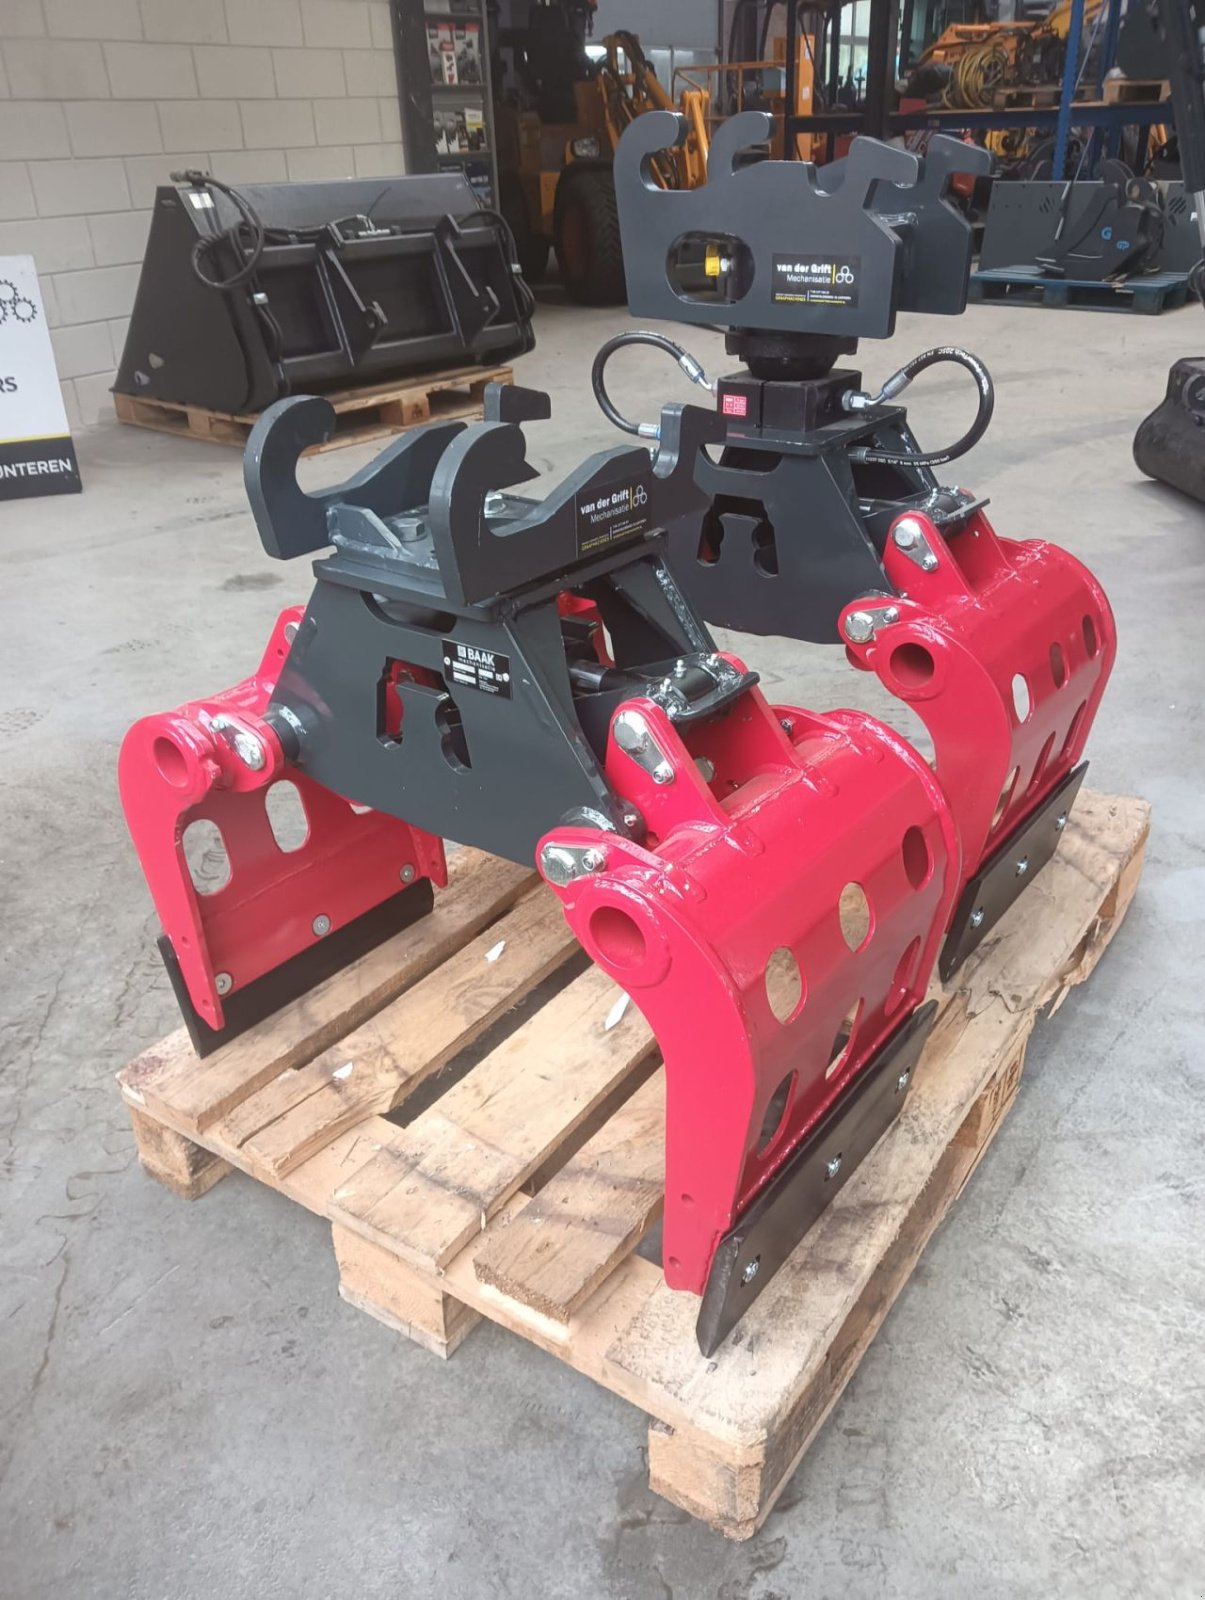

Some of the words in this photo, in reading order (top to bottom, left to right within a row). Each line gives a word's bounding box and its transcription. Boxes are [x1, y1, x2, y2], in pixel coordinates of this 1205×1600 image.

[776, 264, 793, 272] van
[794, 263, 810, 273] der
[811, 263, 832, 274] Grift
[786, 274, 832, 284] Mechanisatie
[580, 502, 595, 515] van
[596, 497, 611, 509] der
[611, 489, 630, 504] Grift
[590, 503, 630, 524] Mechanisatie
[467, 647, 496, 667] BAAK
